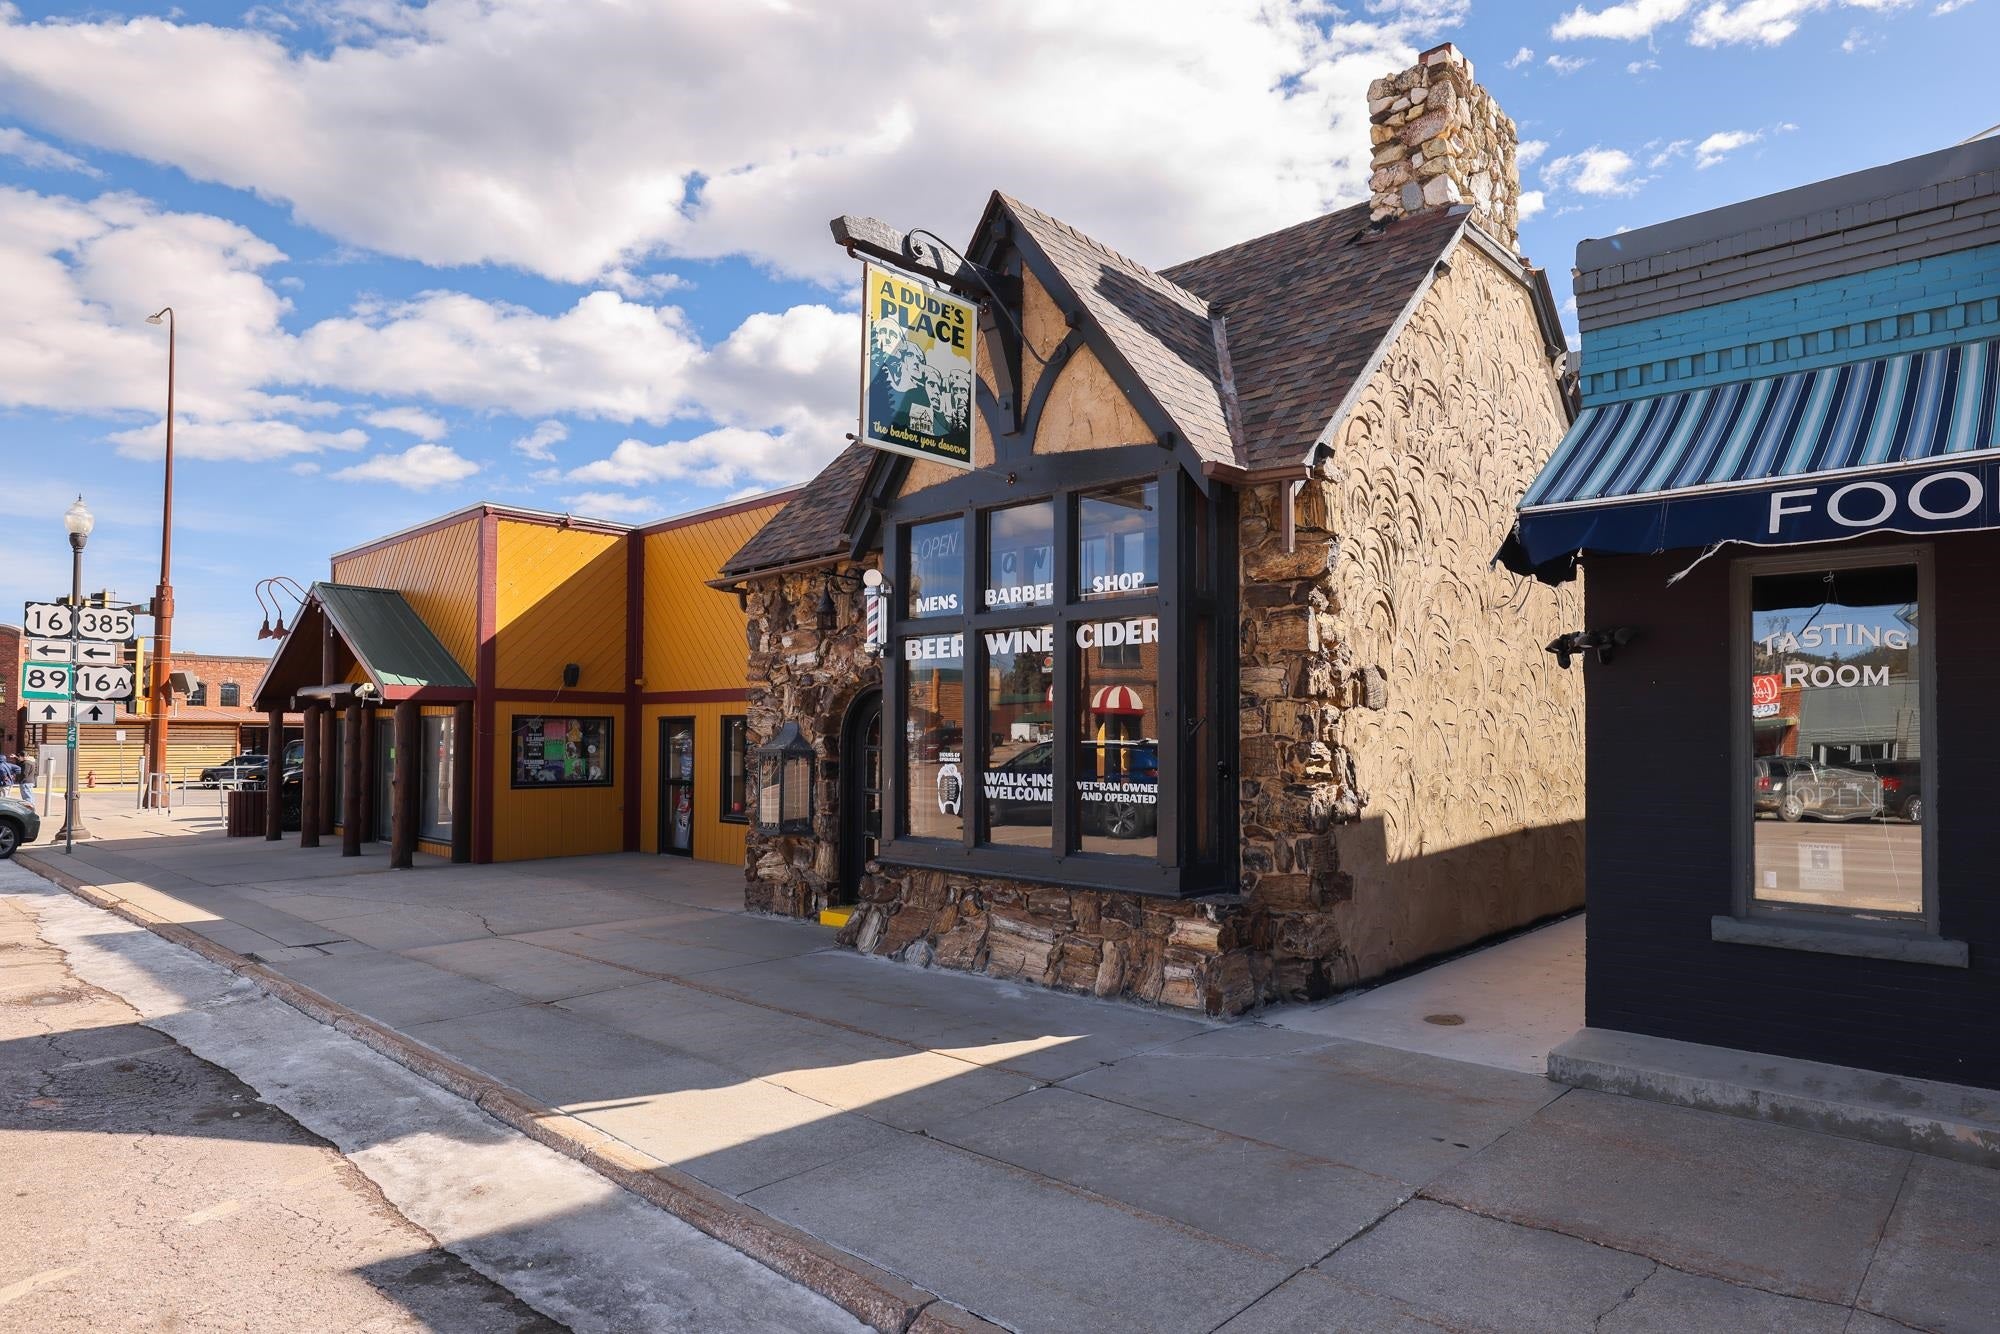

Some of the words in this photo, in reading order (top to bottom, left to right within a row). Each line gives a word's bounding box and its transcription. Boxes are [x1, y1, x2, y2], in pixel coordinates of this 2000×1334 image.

[880, 281, 895, 299] A
[901, 287, 964, 325] DUDE'S
[881, 299, 965, 349] PLACE
[873, 421, 888, 434] the
[890, 425, 919, 443] barber
[920, 436, 936, 448] you
[938, 438, 967, 455] deserve
[1769, 466, 2000, 534] FOO
[921, 532, 959, 560] OPEN
[916, 594, 957, 613] MENS
[1092, 572, 1144, 593] SHOP
[34, 611, 63, 631] 16
[83, 613, 129, 634] 385
[905, 636, 964, 660] BEER
[985, 630, 1054, 655] WINE
[1076, 619, 1158, 648] CIDER
[1759, 623, 1909, 656] TASTING
[27, 669, 67, 690] 89
[1785, 664, 1890, 688] ROOM
[1081, 792, 1102, 801] AND
[1104, 793, 1156, 804] OPERATED
[1794, 786, 1877, 807] OPEN
